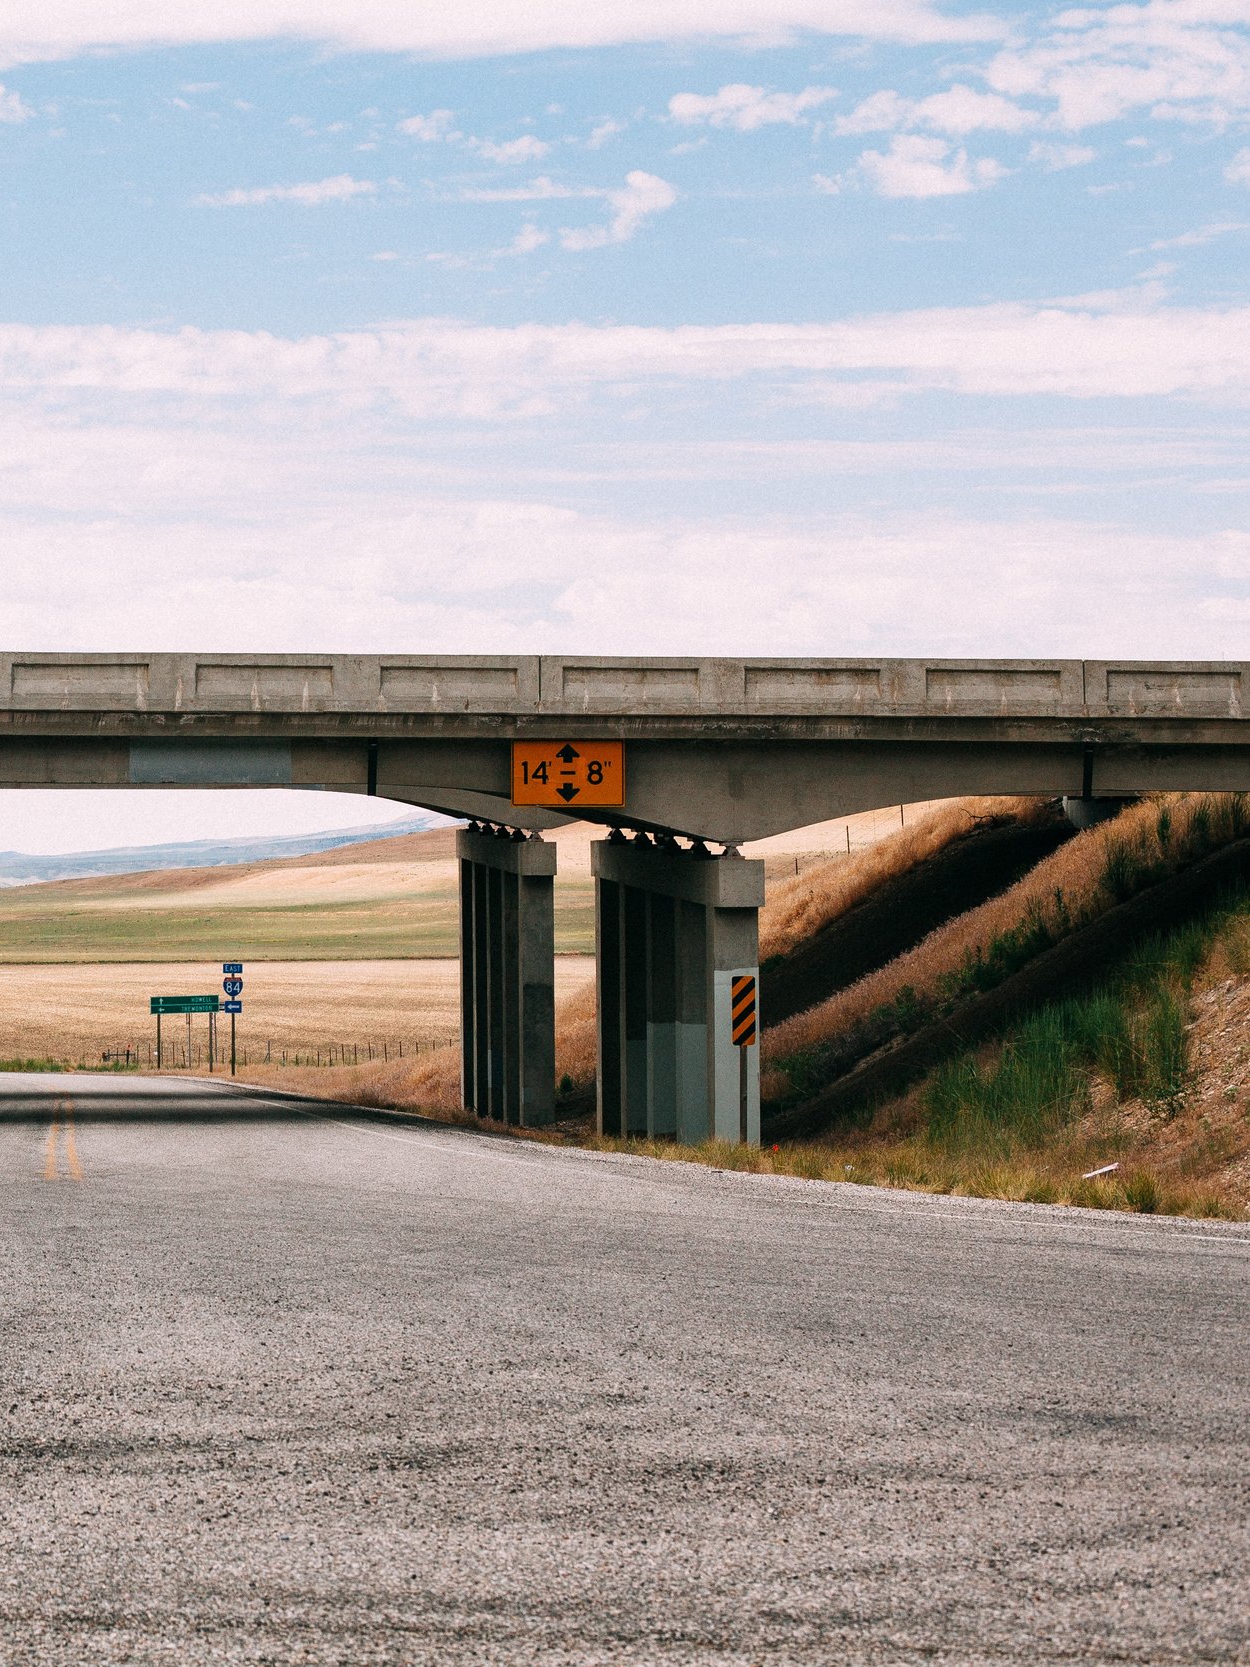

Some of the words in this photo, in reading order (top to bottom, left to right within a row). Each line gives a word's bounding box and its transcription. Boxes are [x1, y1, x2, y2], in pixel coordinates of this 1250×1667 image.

[521, 761, 551, 785] 14'
[587, 760, 612, 785] 8"
[226, 982, 240, 993] 84
